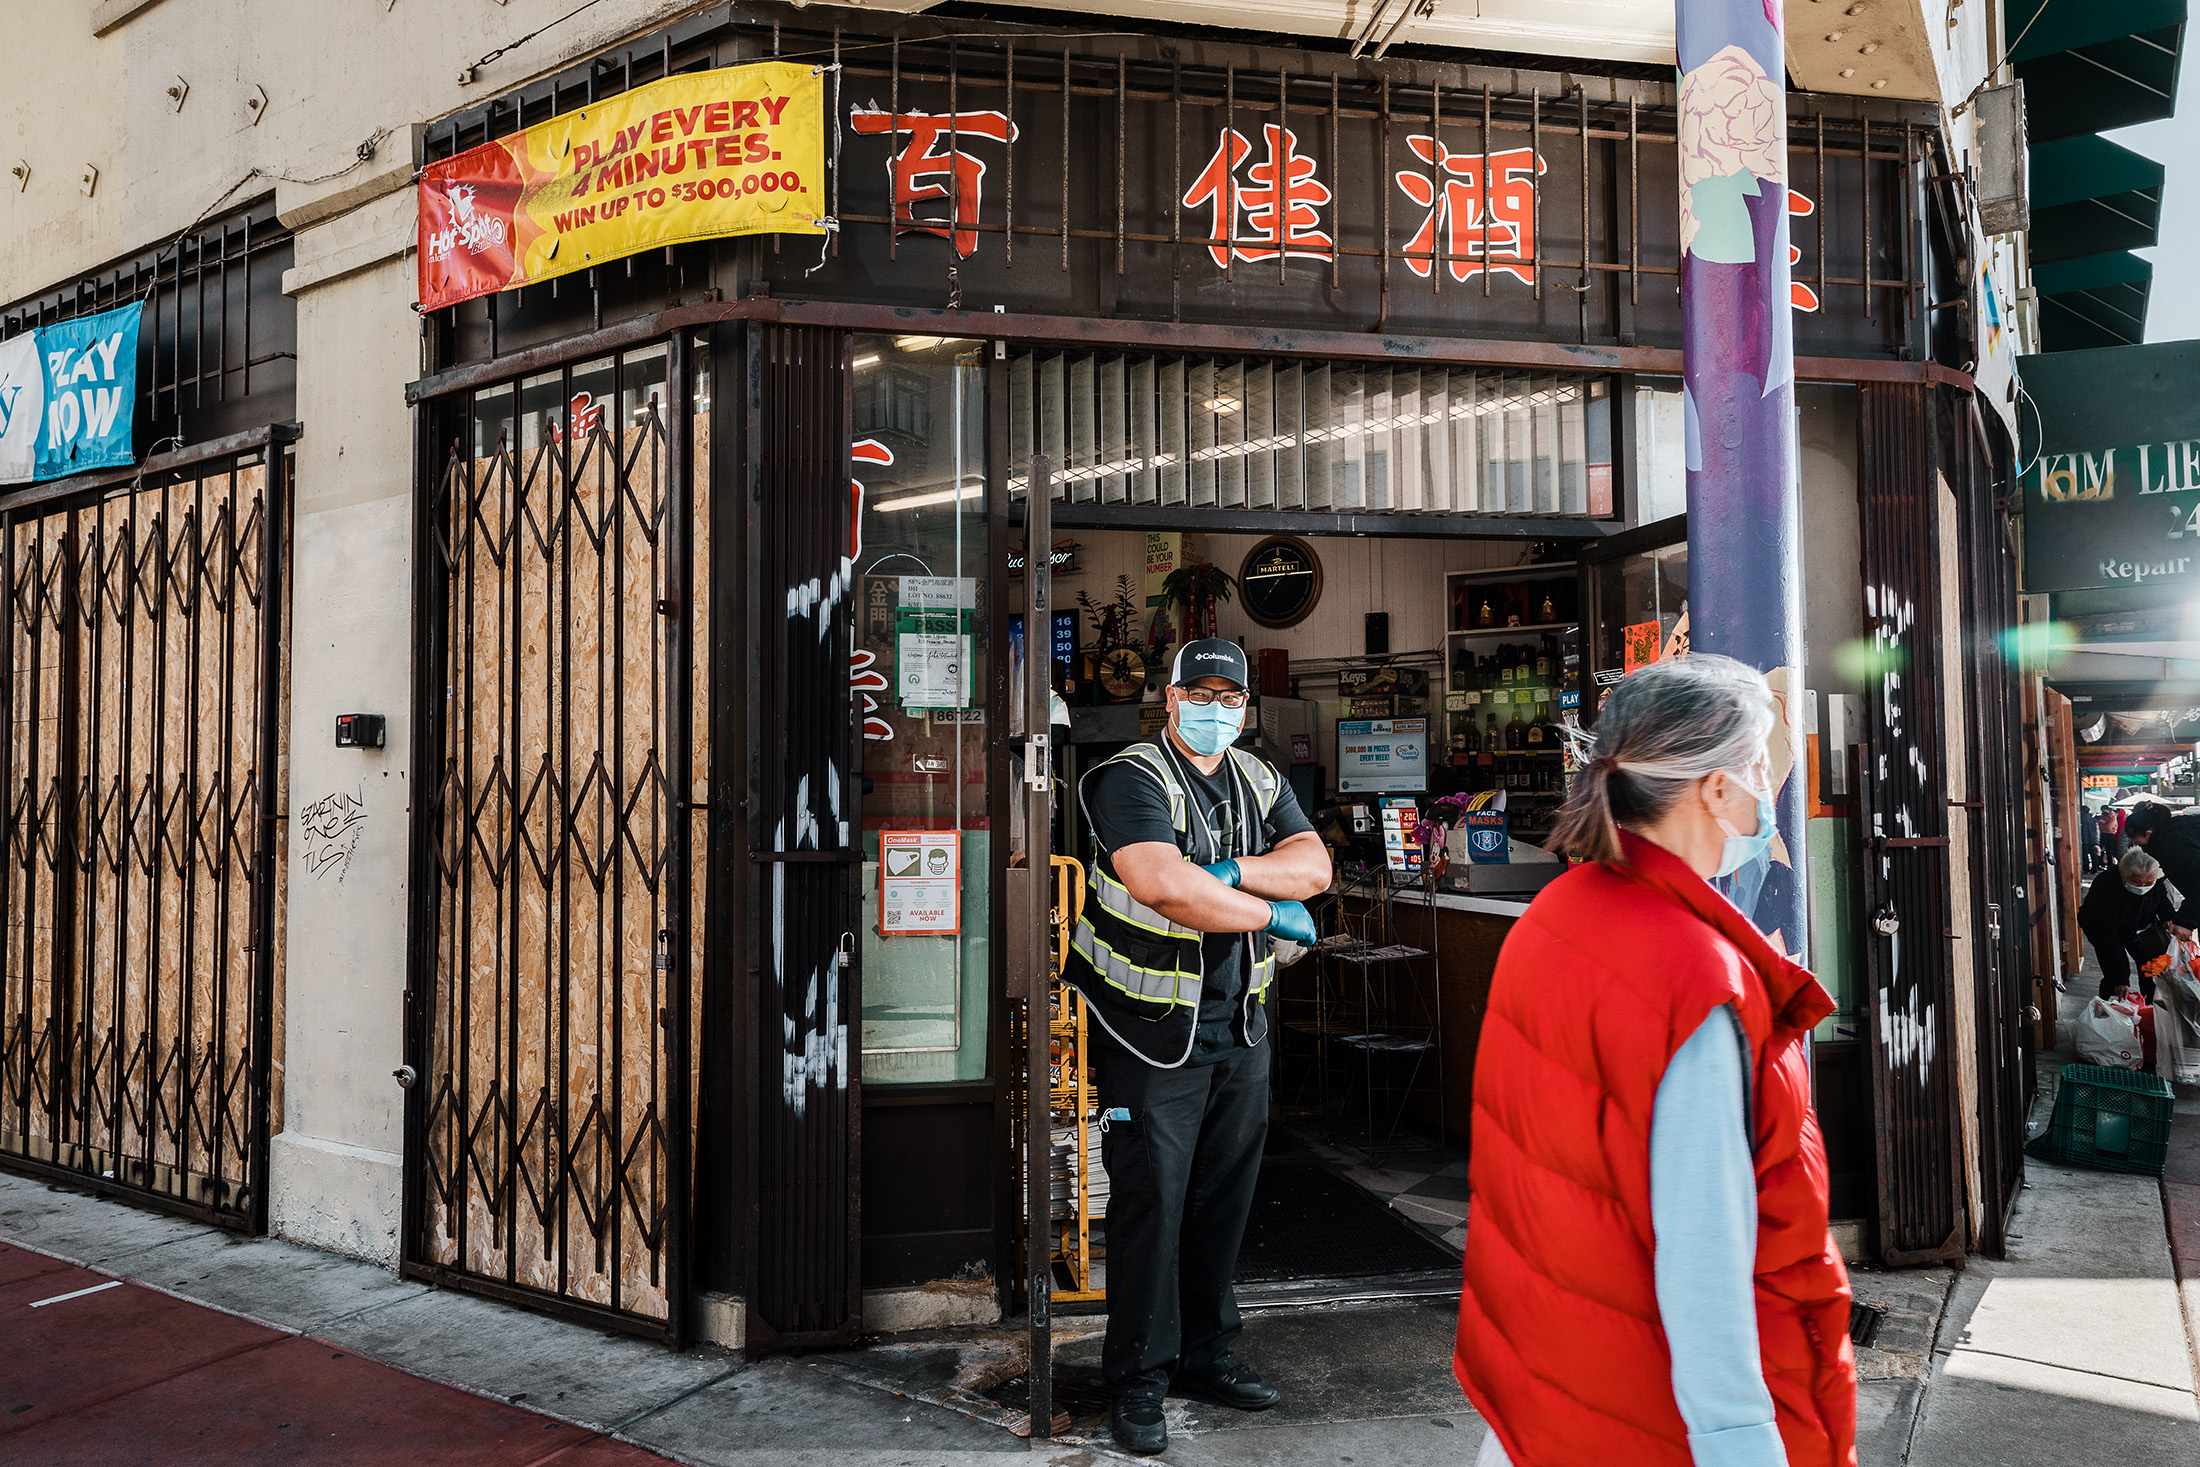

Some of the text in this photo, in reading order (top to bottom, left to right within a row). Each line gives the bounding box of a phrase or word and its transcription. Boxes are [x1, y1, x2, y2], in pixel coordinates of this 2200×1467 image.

[573, 96, 791, 175] PLAY EVERY
[571, 132, 782, 197] 4 MINUTES.
[553, 170, 808, 234] WIN UP TO $300,000.
[429, 213, 492, 256] Hot Spot
[48, 332, 124, 394] PLAY
[48, 386, 122, 449] NOW
[2038, 449, 2116, 501] KIM
[1147, 533, 1160, 543] THIS
[1147, 542, 1169, 553] COULD
[1147, 552, 1173, 564] BE YOUR
[1147, 562, 1172, 574] NUMBER
[1260, 564, 1295, 573] MARTELL
[2100, 555, 2190, 583] Repair
[869, 581, 889, 634] 金門
[914, 619, 957, 633] PASS
[1056, 617, 1072, 627] 16
[1056, 630, 1072, 639] 39
[1056, 642, 1072, 652] 50
[1202, 652, 1234, 663] Columbia
[1340, 671, 1367, 686] Keys
[1562, 694, 1579, 705] PLAY
[1144, 709, 1169, 719] NOTIC
[1468, 816, 1504, 825] MASKS
[888, 836, 918, 844] OneMask
